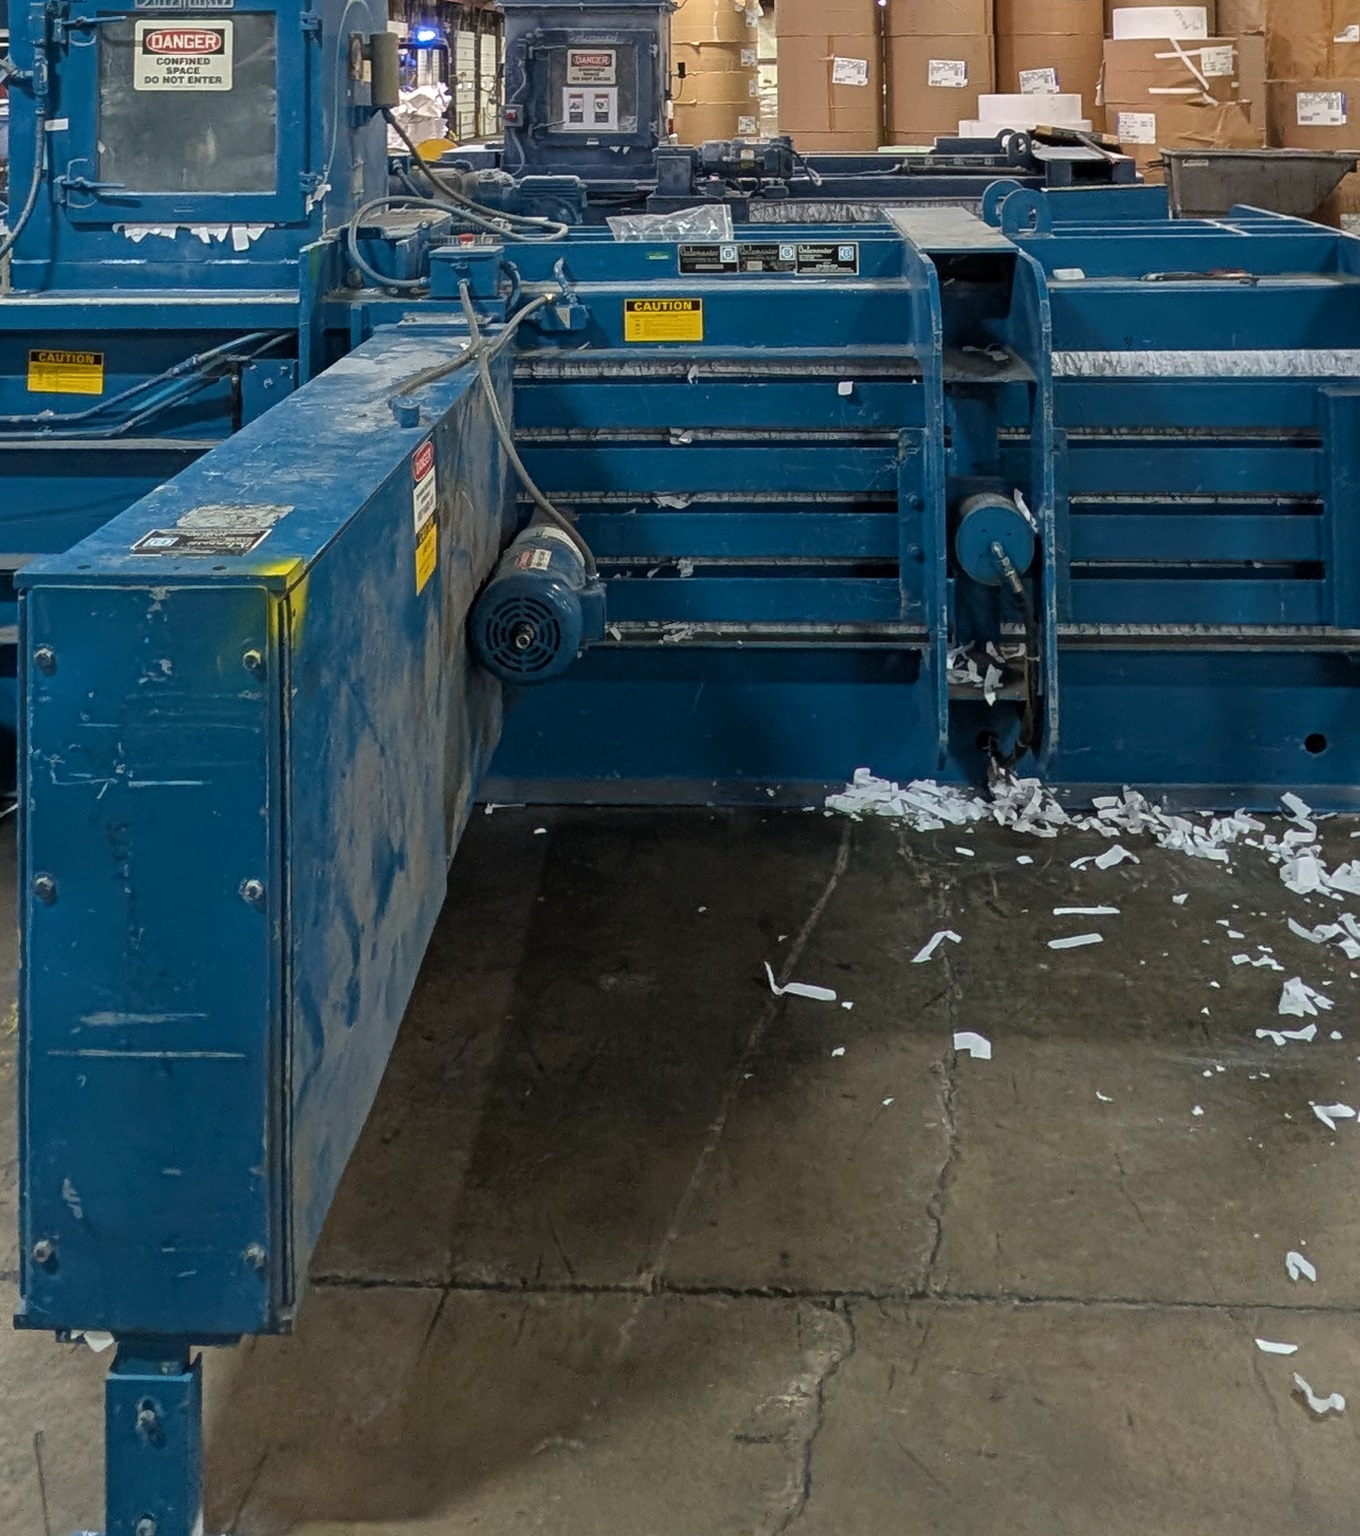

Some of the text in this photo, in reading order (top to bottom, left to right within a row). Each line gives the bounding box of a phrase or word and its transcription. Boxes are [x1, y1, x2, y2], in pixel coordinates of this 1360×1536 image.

[151, 34, 216, 49] DANGER
[156, 57, 211, 65] CONFINED
[575, 55, 609, 64] DANGER
[166, 66, 200, 75] SPACE
[144, 76, 222, 84] DO NOT ENTER
[634, 301, 692, 311] CAUTION
[38, 352, 95, 364] CAUTION
